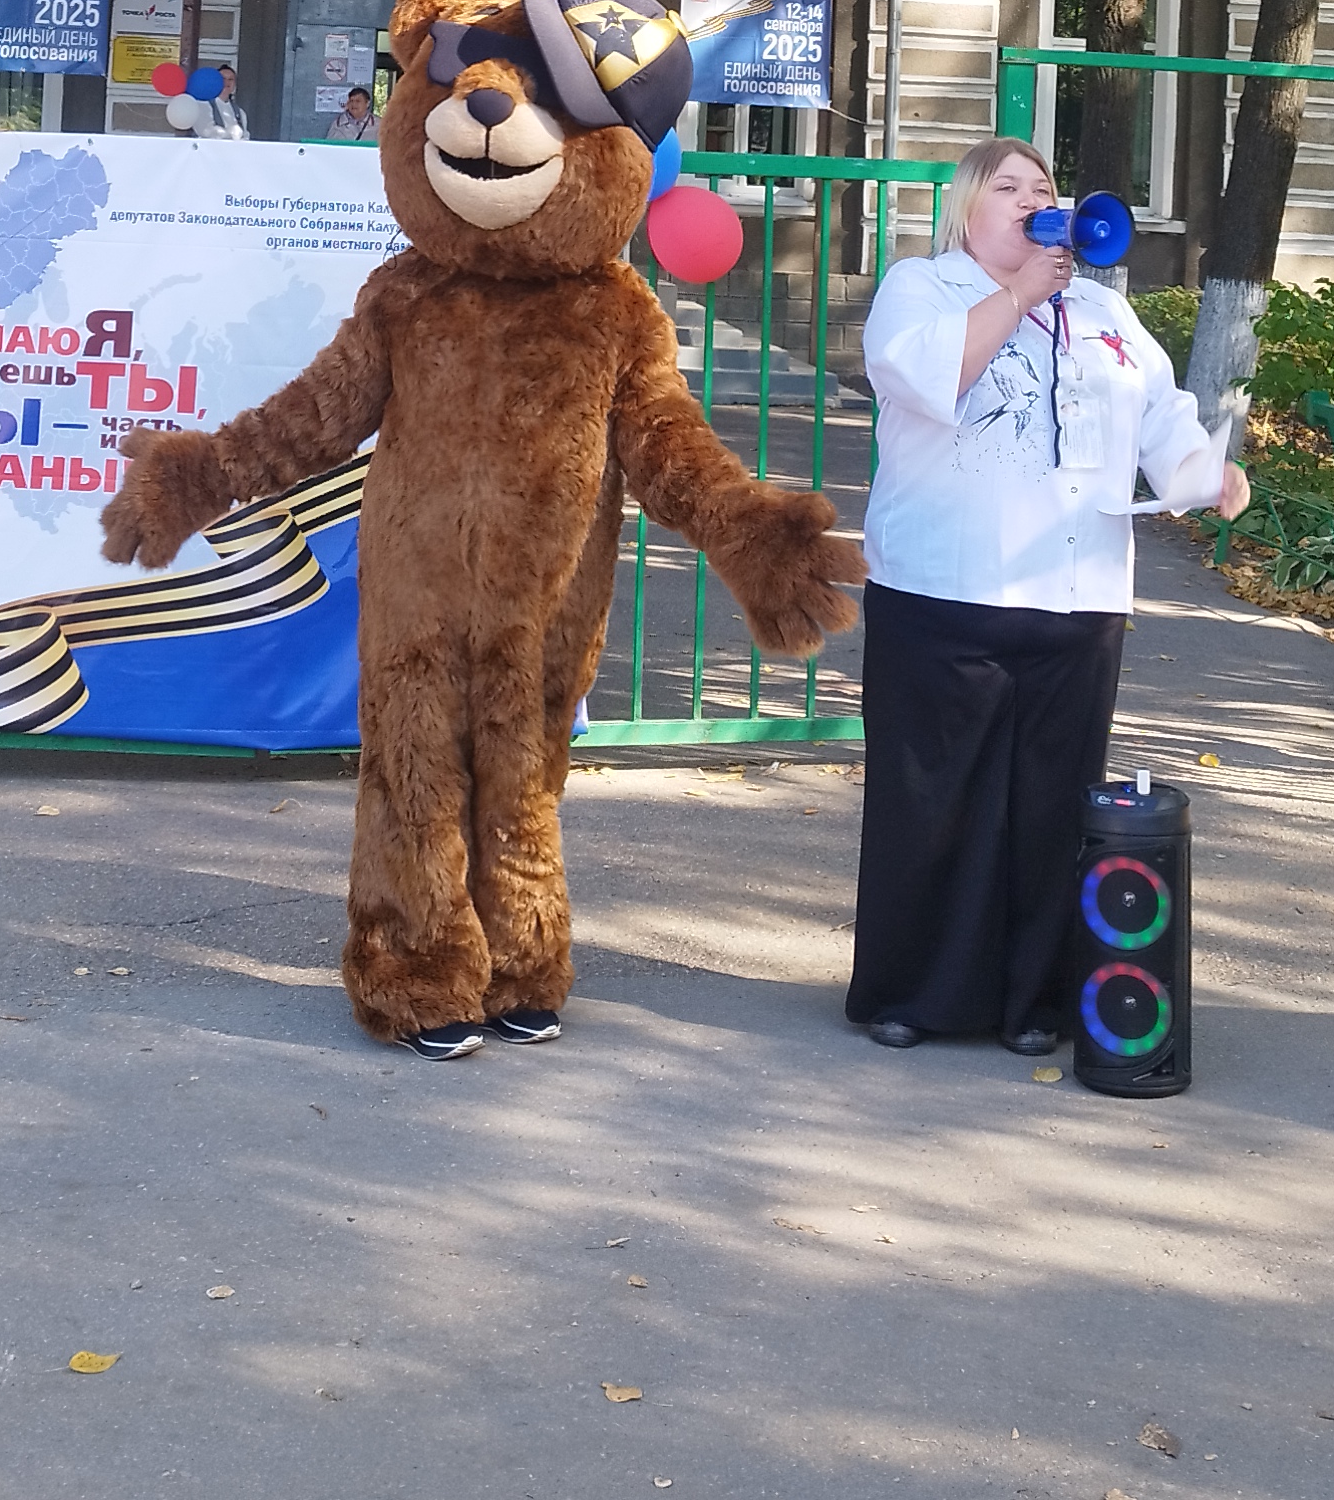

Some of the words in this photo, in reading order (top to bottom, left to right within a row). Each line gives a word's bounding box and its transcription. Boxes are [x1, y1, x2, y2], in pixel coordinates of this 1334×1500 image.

[786, 3, 824, 20] 12-14
[764, 18, 823, 36] сентября
[59, 31, 98, 47] ДЕНЬ
[762, 33, 822, 62] 2025
[724, 61, 782, 80] ЕДИНЫЙ
[785, 65, 822, 82] ДЕНЬ
[723, 79, 821, 97] голосования
[224, 194, 279, 211] Выборы
[282, 196, 364, 215] Губернатора
[367, 201, 393, 217] Кал
[109, 210, 175, 226] депутатов
[178, 211, 296, 231] Законодательного
[300, 217, 363, 233] Собрания
[266, 236, 319, 252] органов
[322, 238, 382, 251] местного
[83, 309, 144, 362] Я,
[76, 361, 207, 420] ТЫ,
